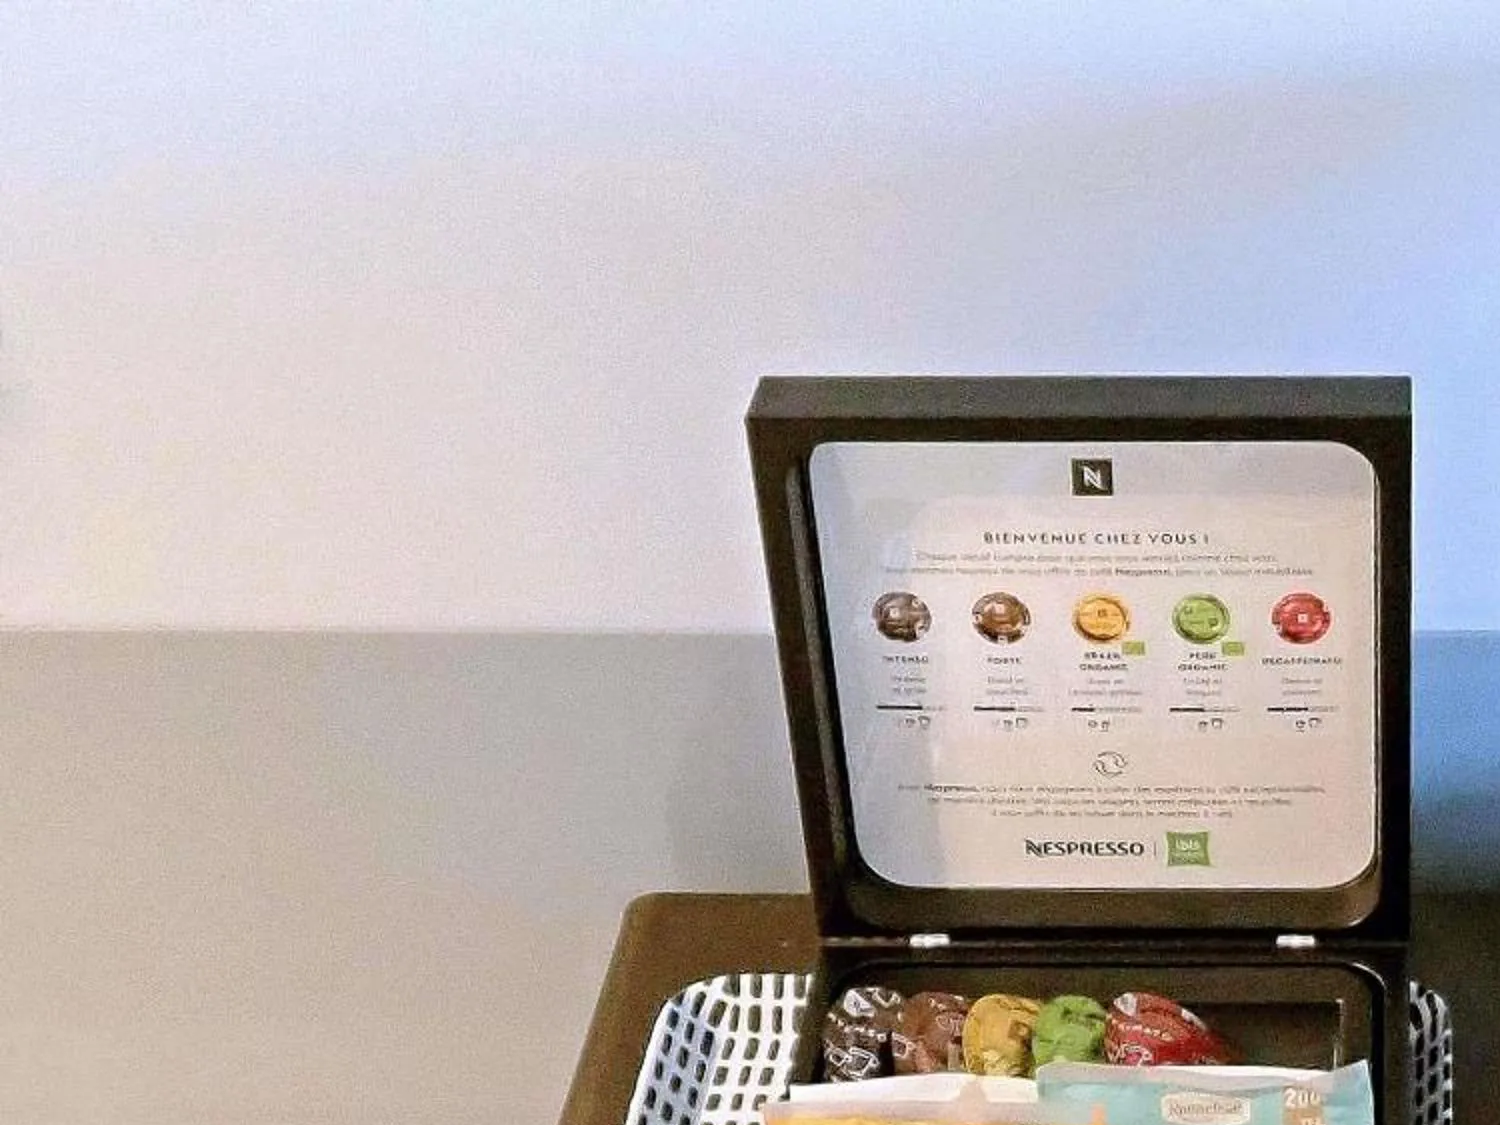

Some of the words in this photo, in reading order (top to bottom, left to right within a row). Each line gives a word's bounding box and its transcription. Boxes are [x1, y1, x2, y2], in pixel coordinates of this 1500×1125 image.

[983, 531, 1087, 546] BIENVENUE
[1094, 532, 1141, 546] CHEZ
[1149, 532, 1198, 546] VOUS
[1024, 838, 1145, 858] NESPRESSO
[1283, 1086, 1322, 1109] 200
